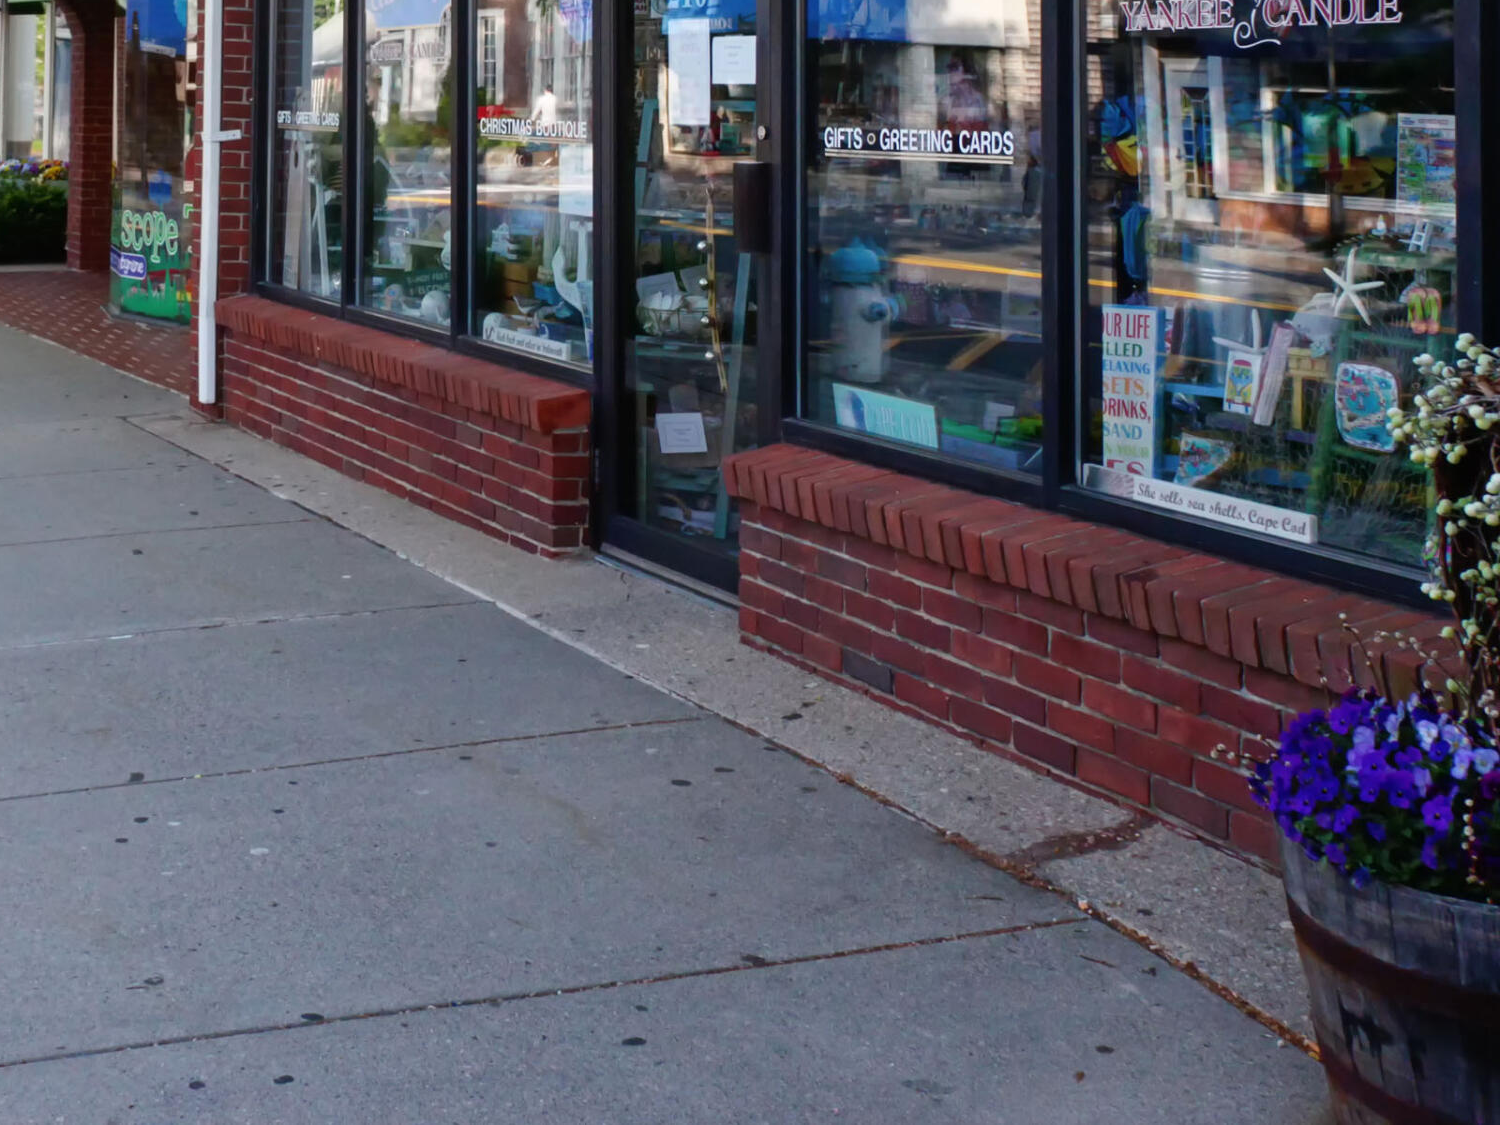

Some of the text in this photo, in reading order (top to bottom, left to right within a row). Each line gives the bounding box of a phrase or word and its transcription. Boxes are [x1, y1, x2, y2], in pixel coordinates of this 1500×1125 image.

[277, 110, 291, 124] GIFTS
[322, 113, 340, 126] CARDS
[480, 118, 588, 138] CHRISTMAS BOUTIQUE
[824, 127, 1014, 155] GIFTS GREETING CARDS
[1126, 314, 1150, 340] LIFE
[1104, 422, 1142, 440] SAND
[1137, 483, 1156, 500] She
[1160, 491, 1183, 506] sells
[1187, 499, 1205, 511] sea
[1248, 510, 1278, 529] Cape
[1282, 518, 1307, 536] Cod
